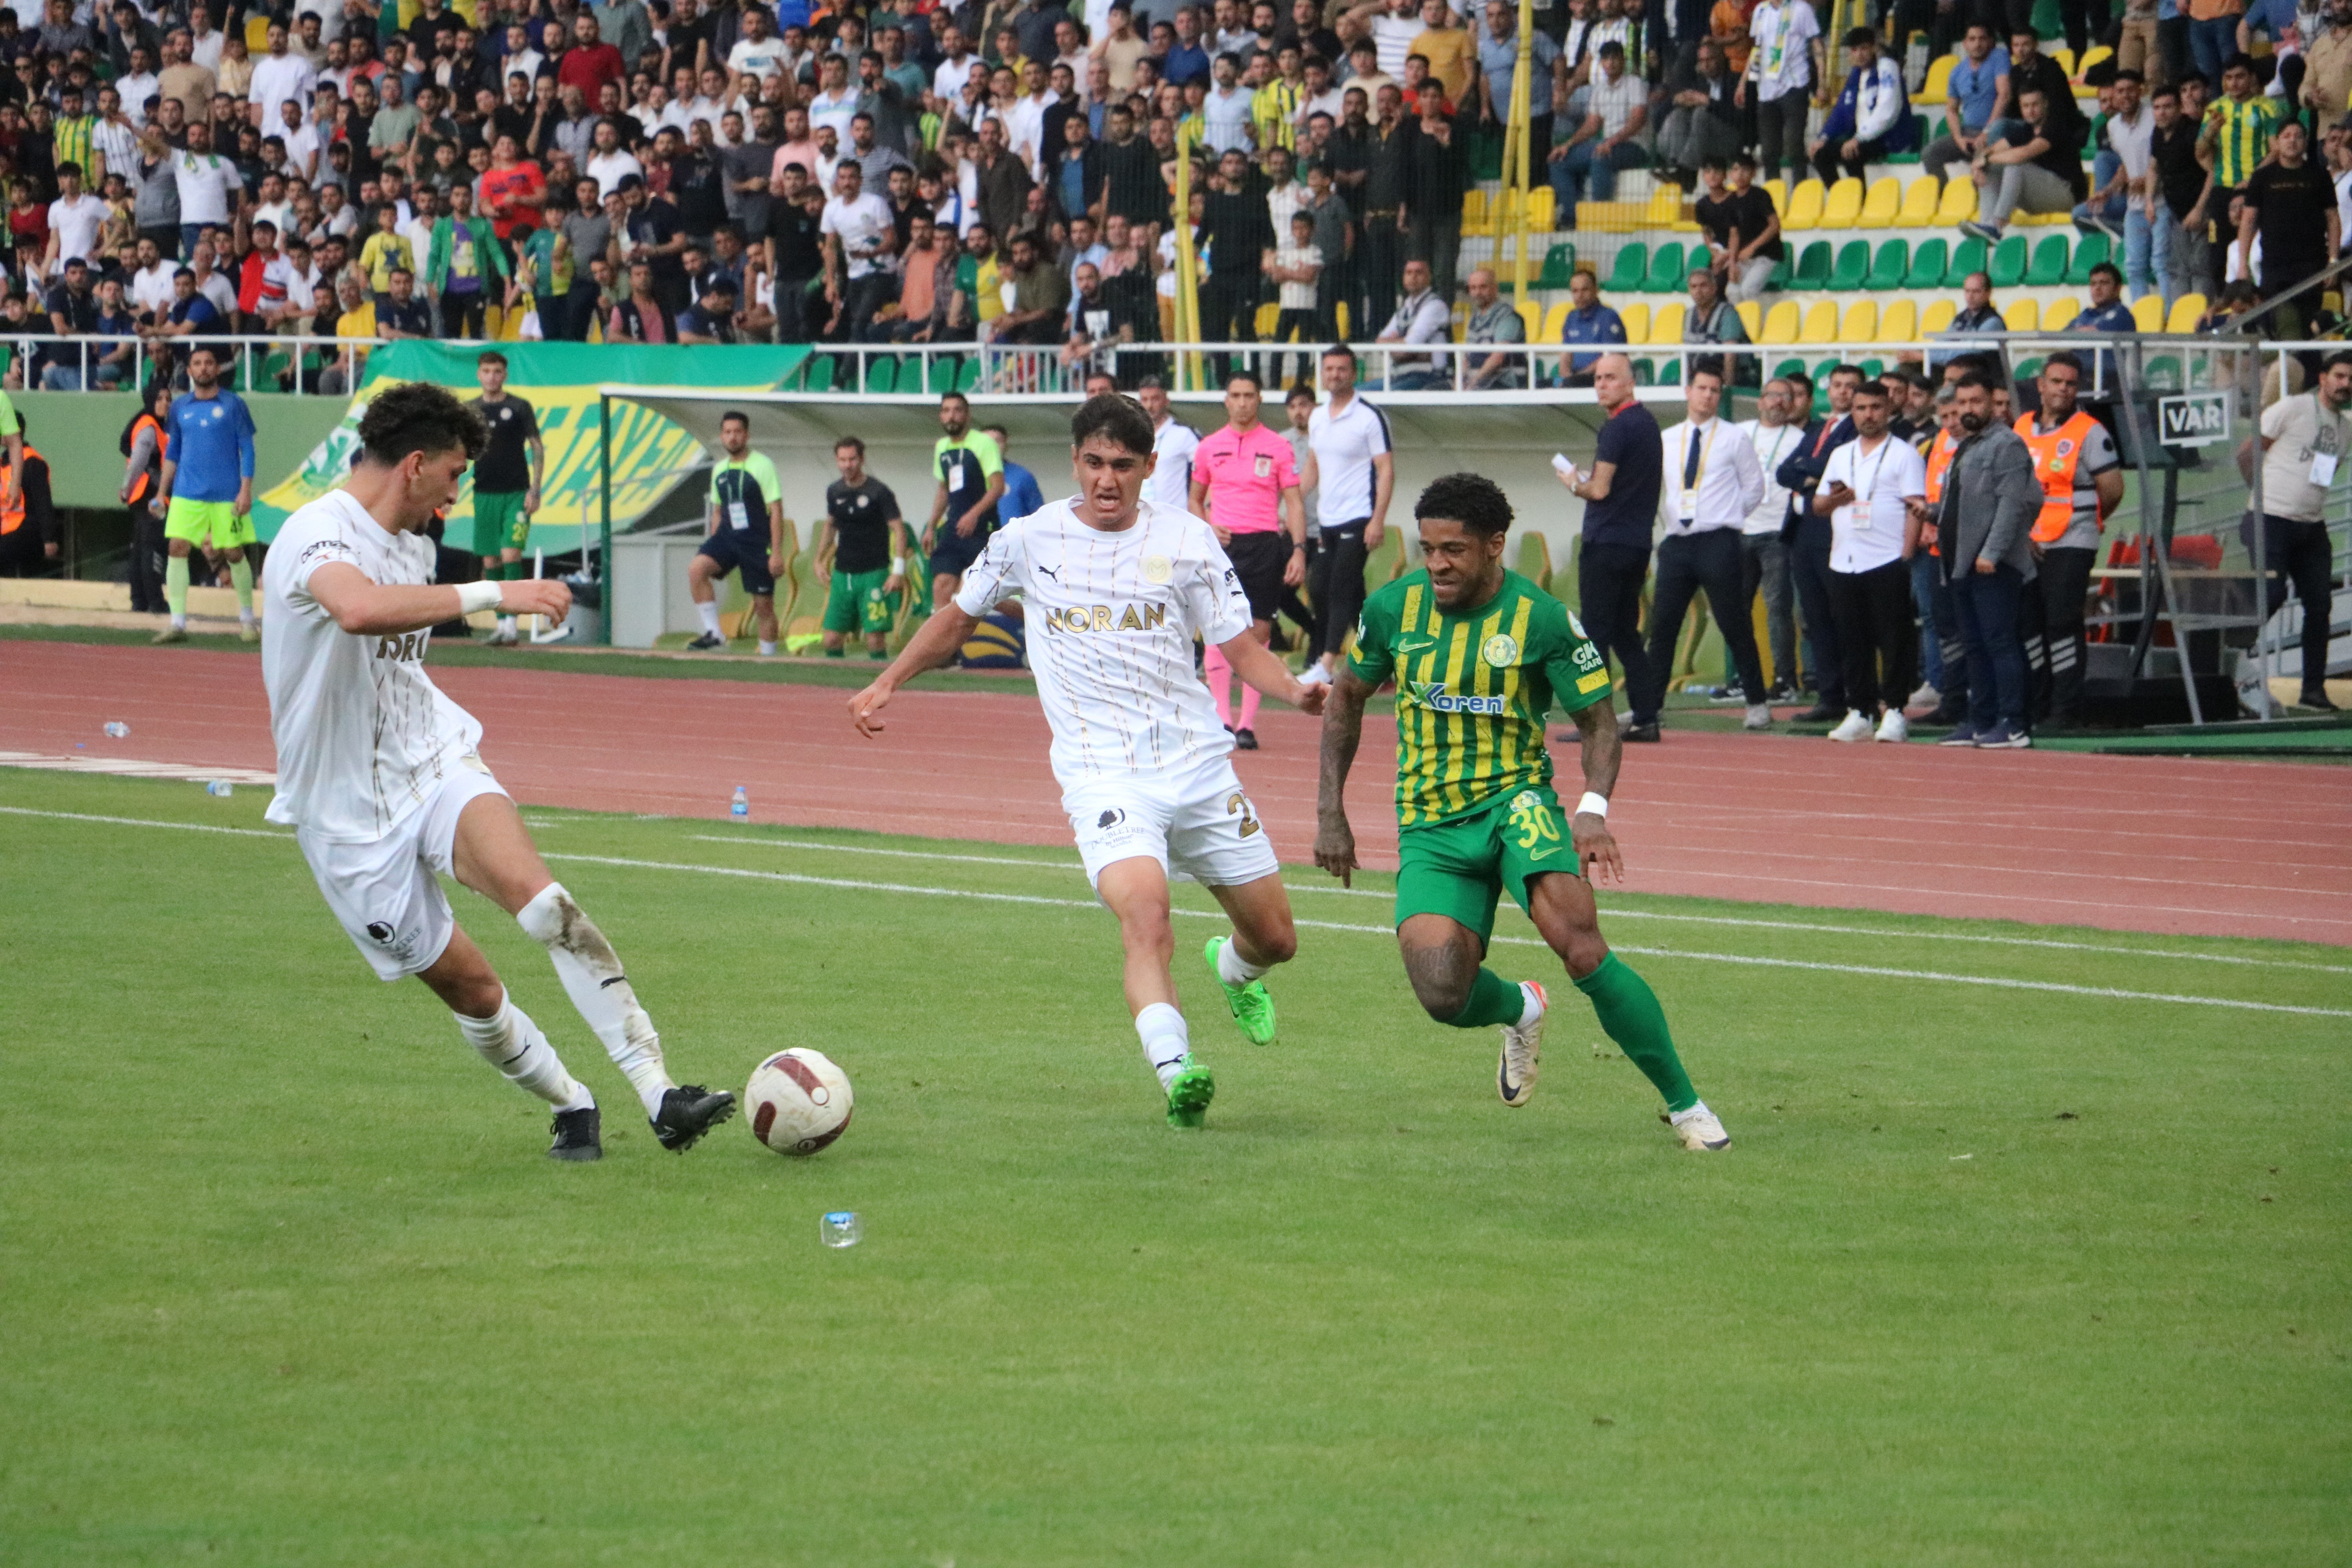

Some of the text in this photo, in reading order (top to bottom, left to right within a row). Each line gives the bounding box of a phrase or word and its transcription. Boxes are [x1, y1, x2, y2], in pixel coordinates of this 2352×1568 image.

[2167, 405, 2220, 432] VAR
[867, 601, 887, 621] 24
[1046, 603, 1165, 635] NORAN
[1092, 826, 1145, 849] DOUBLETREE
[1509, 805, 1560, 848] 30
